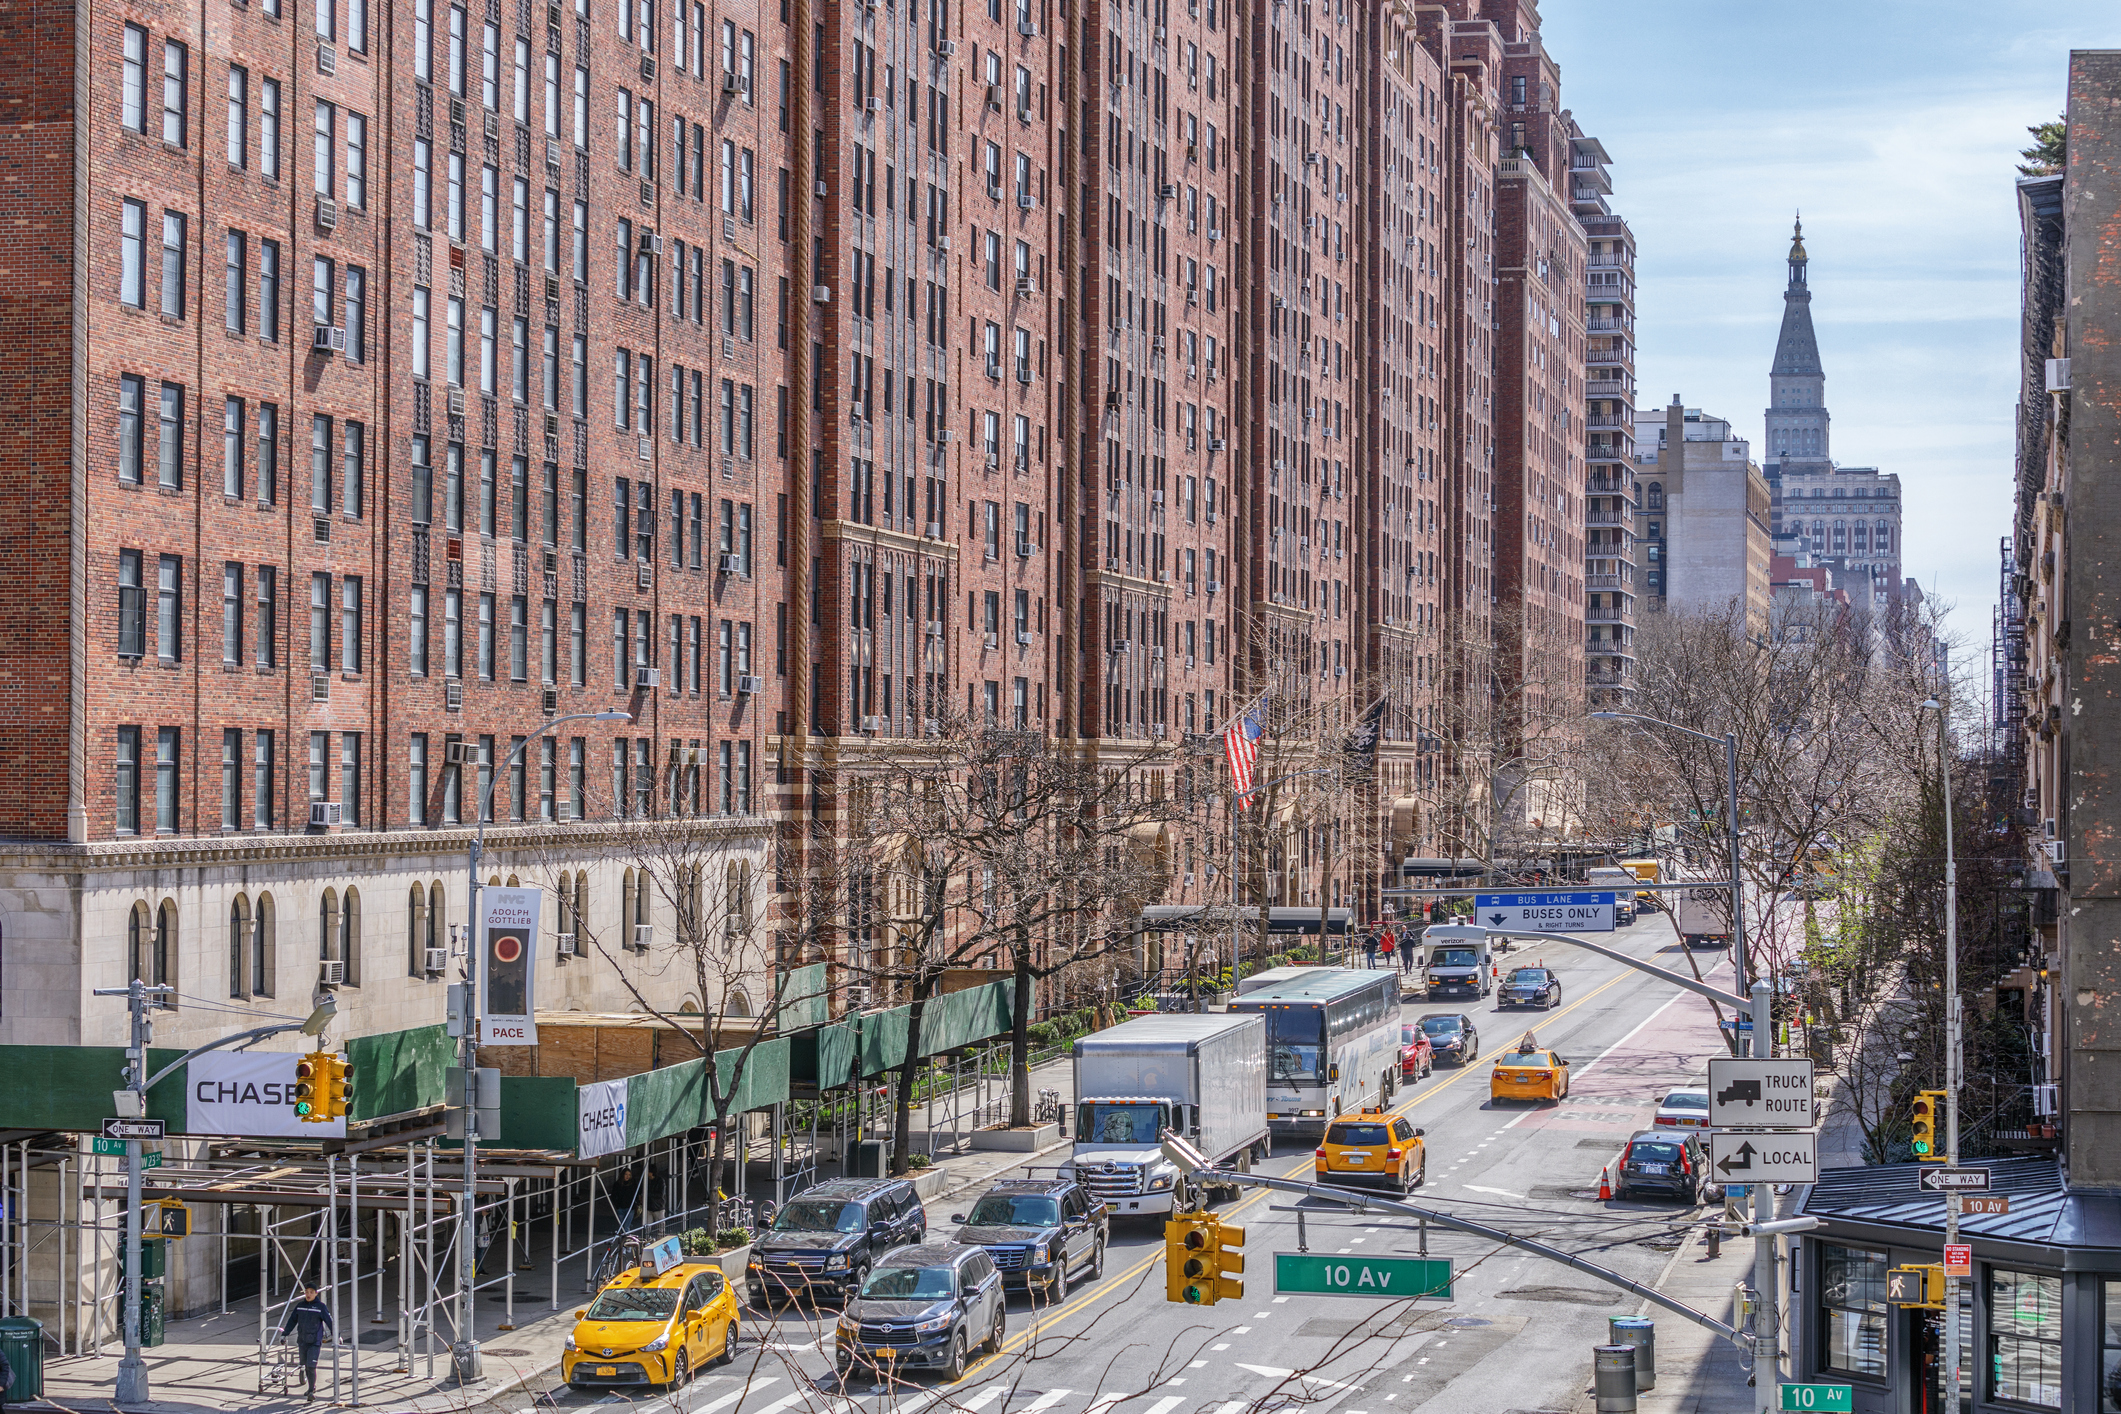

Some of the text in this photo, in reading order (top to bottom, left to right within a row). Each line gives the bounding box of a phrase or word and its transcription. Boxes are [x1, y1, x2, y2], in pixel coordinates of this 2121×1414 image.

[497, 894, 525, 905] NYC
[1518, 895, 1573, 904] BUS LANE
[491, 908, 529, 916] ADOLPH
[1522, 907, 1600, 919] BUSES ONLY
[488, 917, 532, 925] GOTTLIEB
[492, 1028, 524, 1038] PACE
[1765, 1075, 1807, 1088] TRUCK
[196, 1082, 296, 1105] CHASE
[1766, 1099, 1808, 1112] ROUTE
[582, 1108, 615, 1132] CHASE
[112, 1124, 156, 1135] ONE WAY
[96, 1140, 122, 1152] 10 Av
[141, 1156, 148, 1168] W
[148, 1154, 156, 1167] 23
[1763, 1151, 1812, 1164] LOCAL
[1930, 1175, 1980, 1184] ONE WAY
[1970, 1200, 2002, 1212] 10 Av
[1324, 1264, 1392, 1288] 10 Av
[1792, 1388, 1842, 1408] 10 Av
